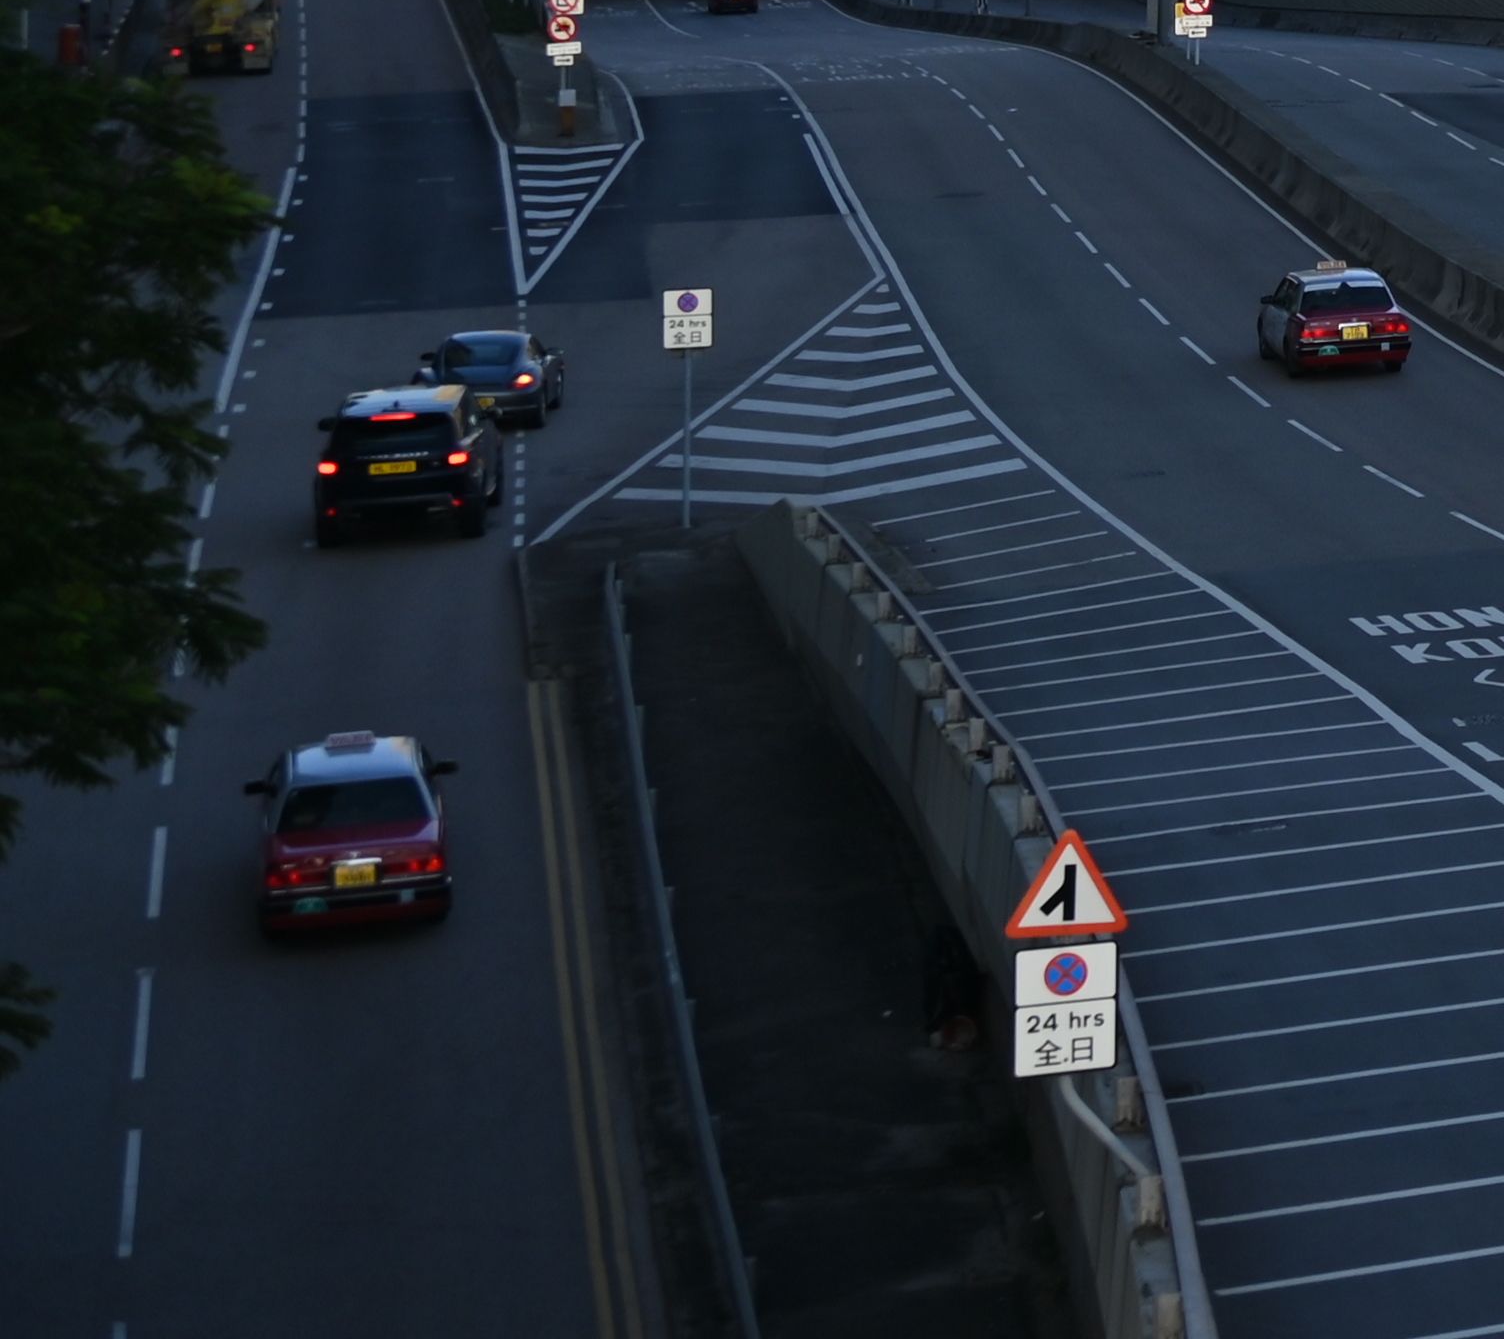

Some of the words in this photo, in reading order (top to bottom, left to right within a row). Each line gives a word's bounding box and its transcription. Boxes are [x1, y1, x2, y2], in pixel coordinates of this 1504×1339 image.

[669, 319, 685, 329] 24
[689, 318, 707, 328] hrs
[673, 331, 702, 344] 全日
[1026, 1016, 1059, 1034] 24
[1068, 1011, 1105, 1030] hrs
[1034, 1037, 1095, 1068] 全日
